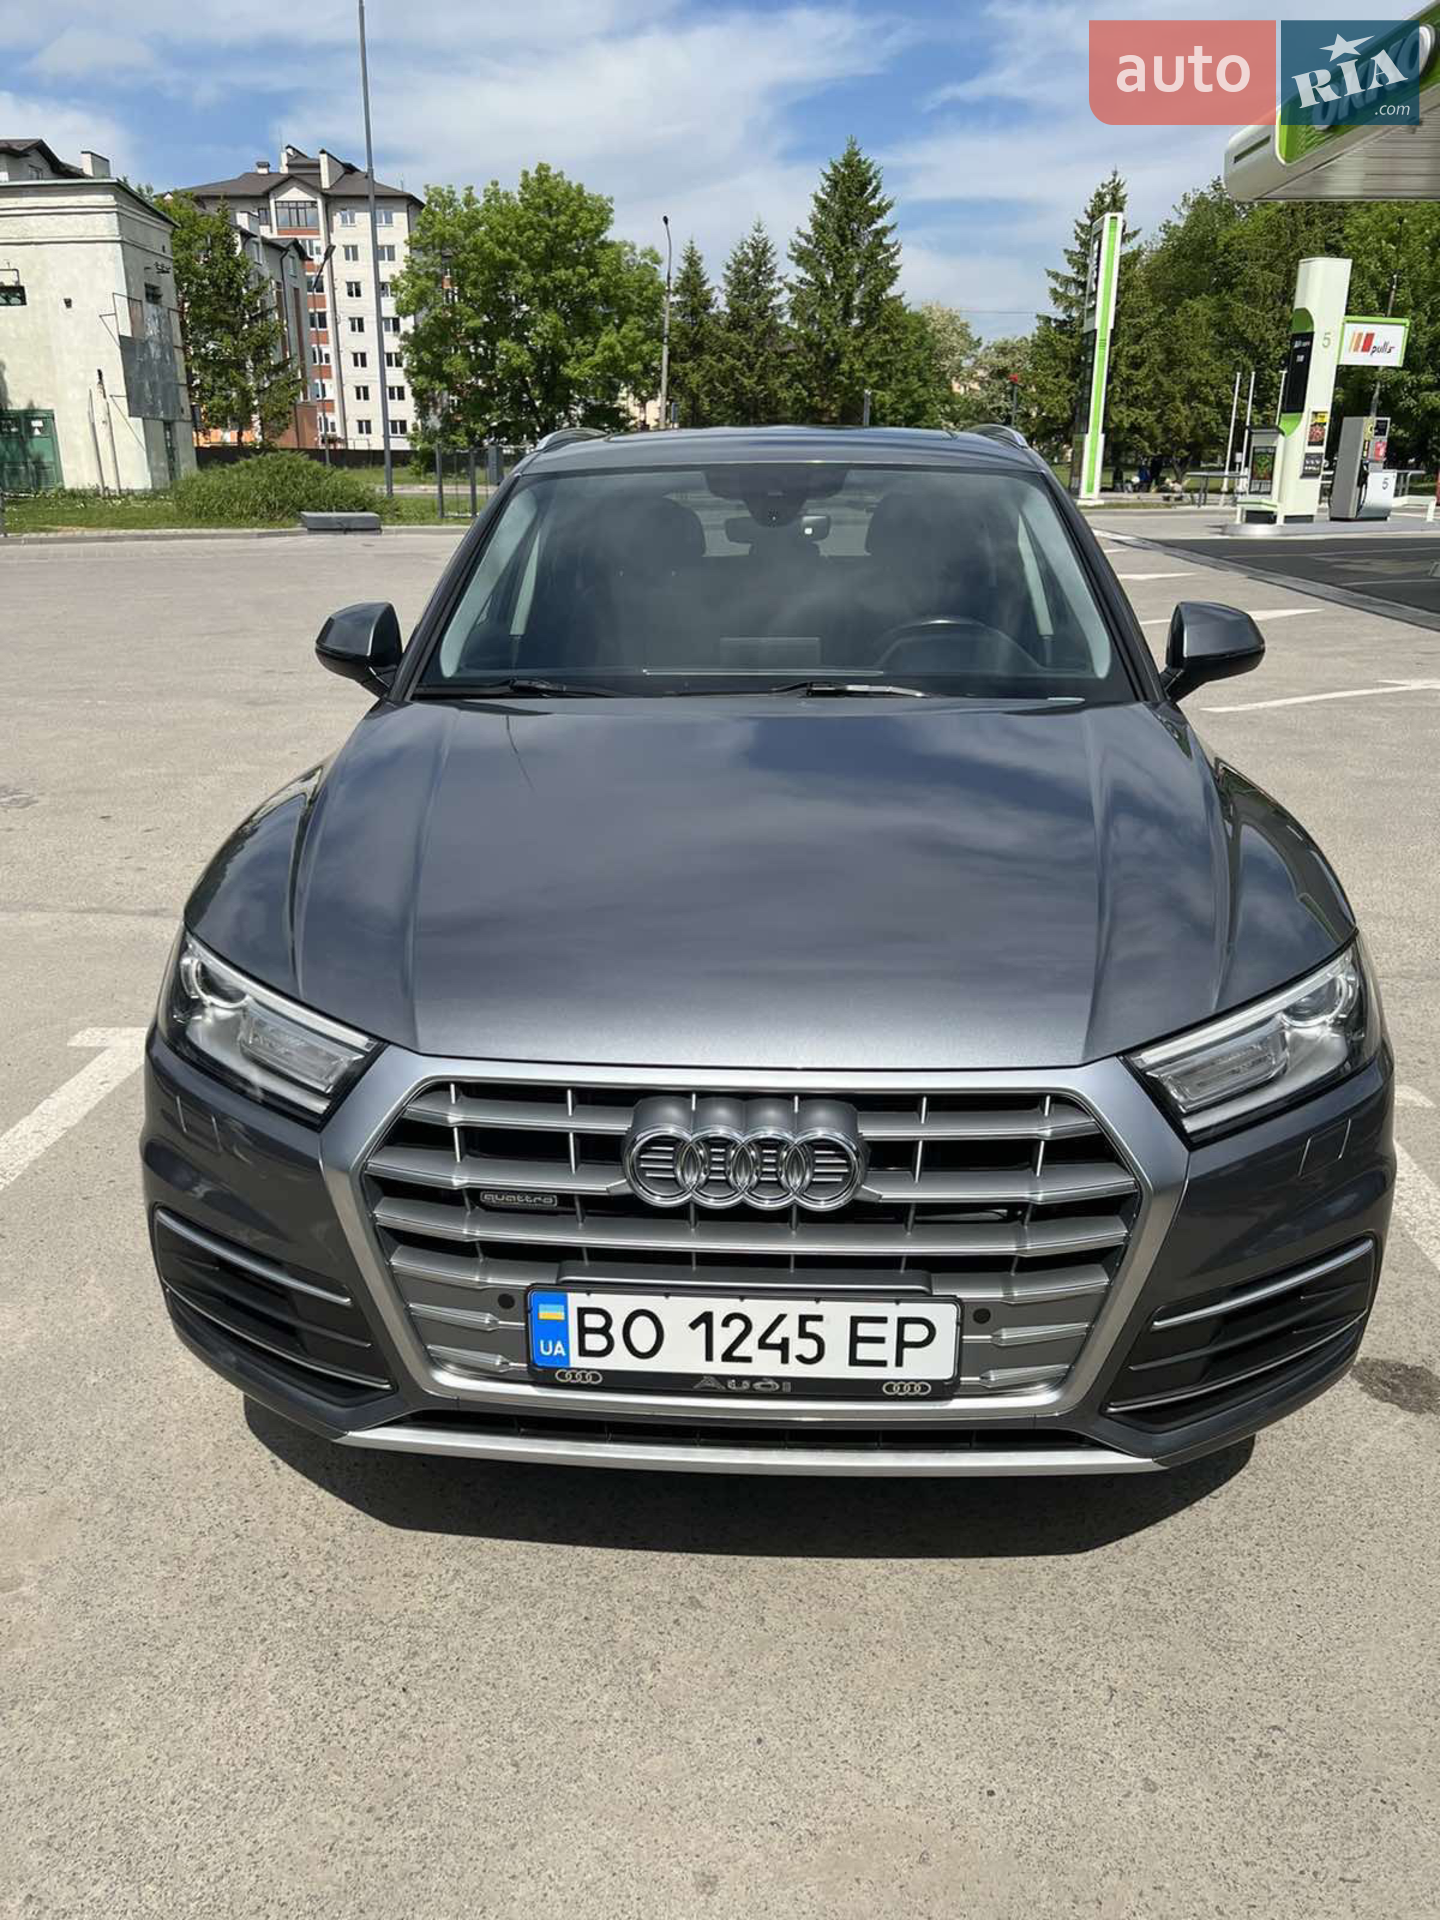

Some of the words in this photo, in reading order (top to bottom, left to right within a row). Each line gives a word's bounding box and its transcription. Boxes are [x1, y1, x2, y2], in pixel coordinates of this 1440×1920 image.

[1321, 332, 1332, 348] 5
[1370, 341, 1396, 356] pulls
[1382, 477, 1390, 490] 5
[483, 1193, 554, 1204] quattro
[577, 1306, 665, 1360] BO
[688, 1310, 826, 1365] 1245
[848, 1315, 937, 1368] EP
[540, 1341, 567, 1356] UA
